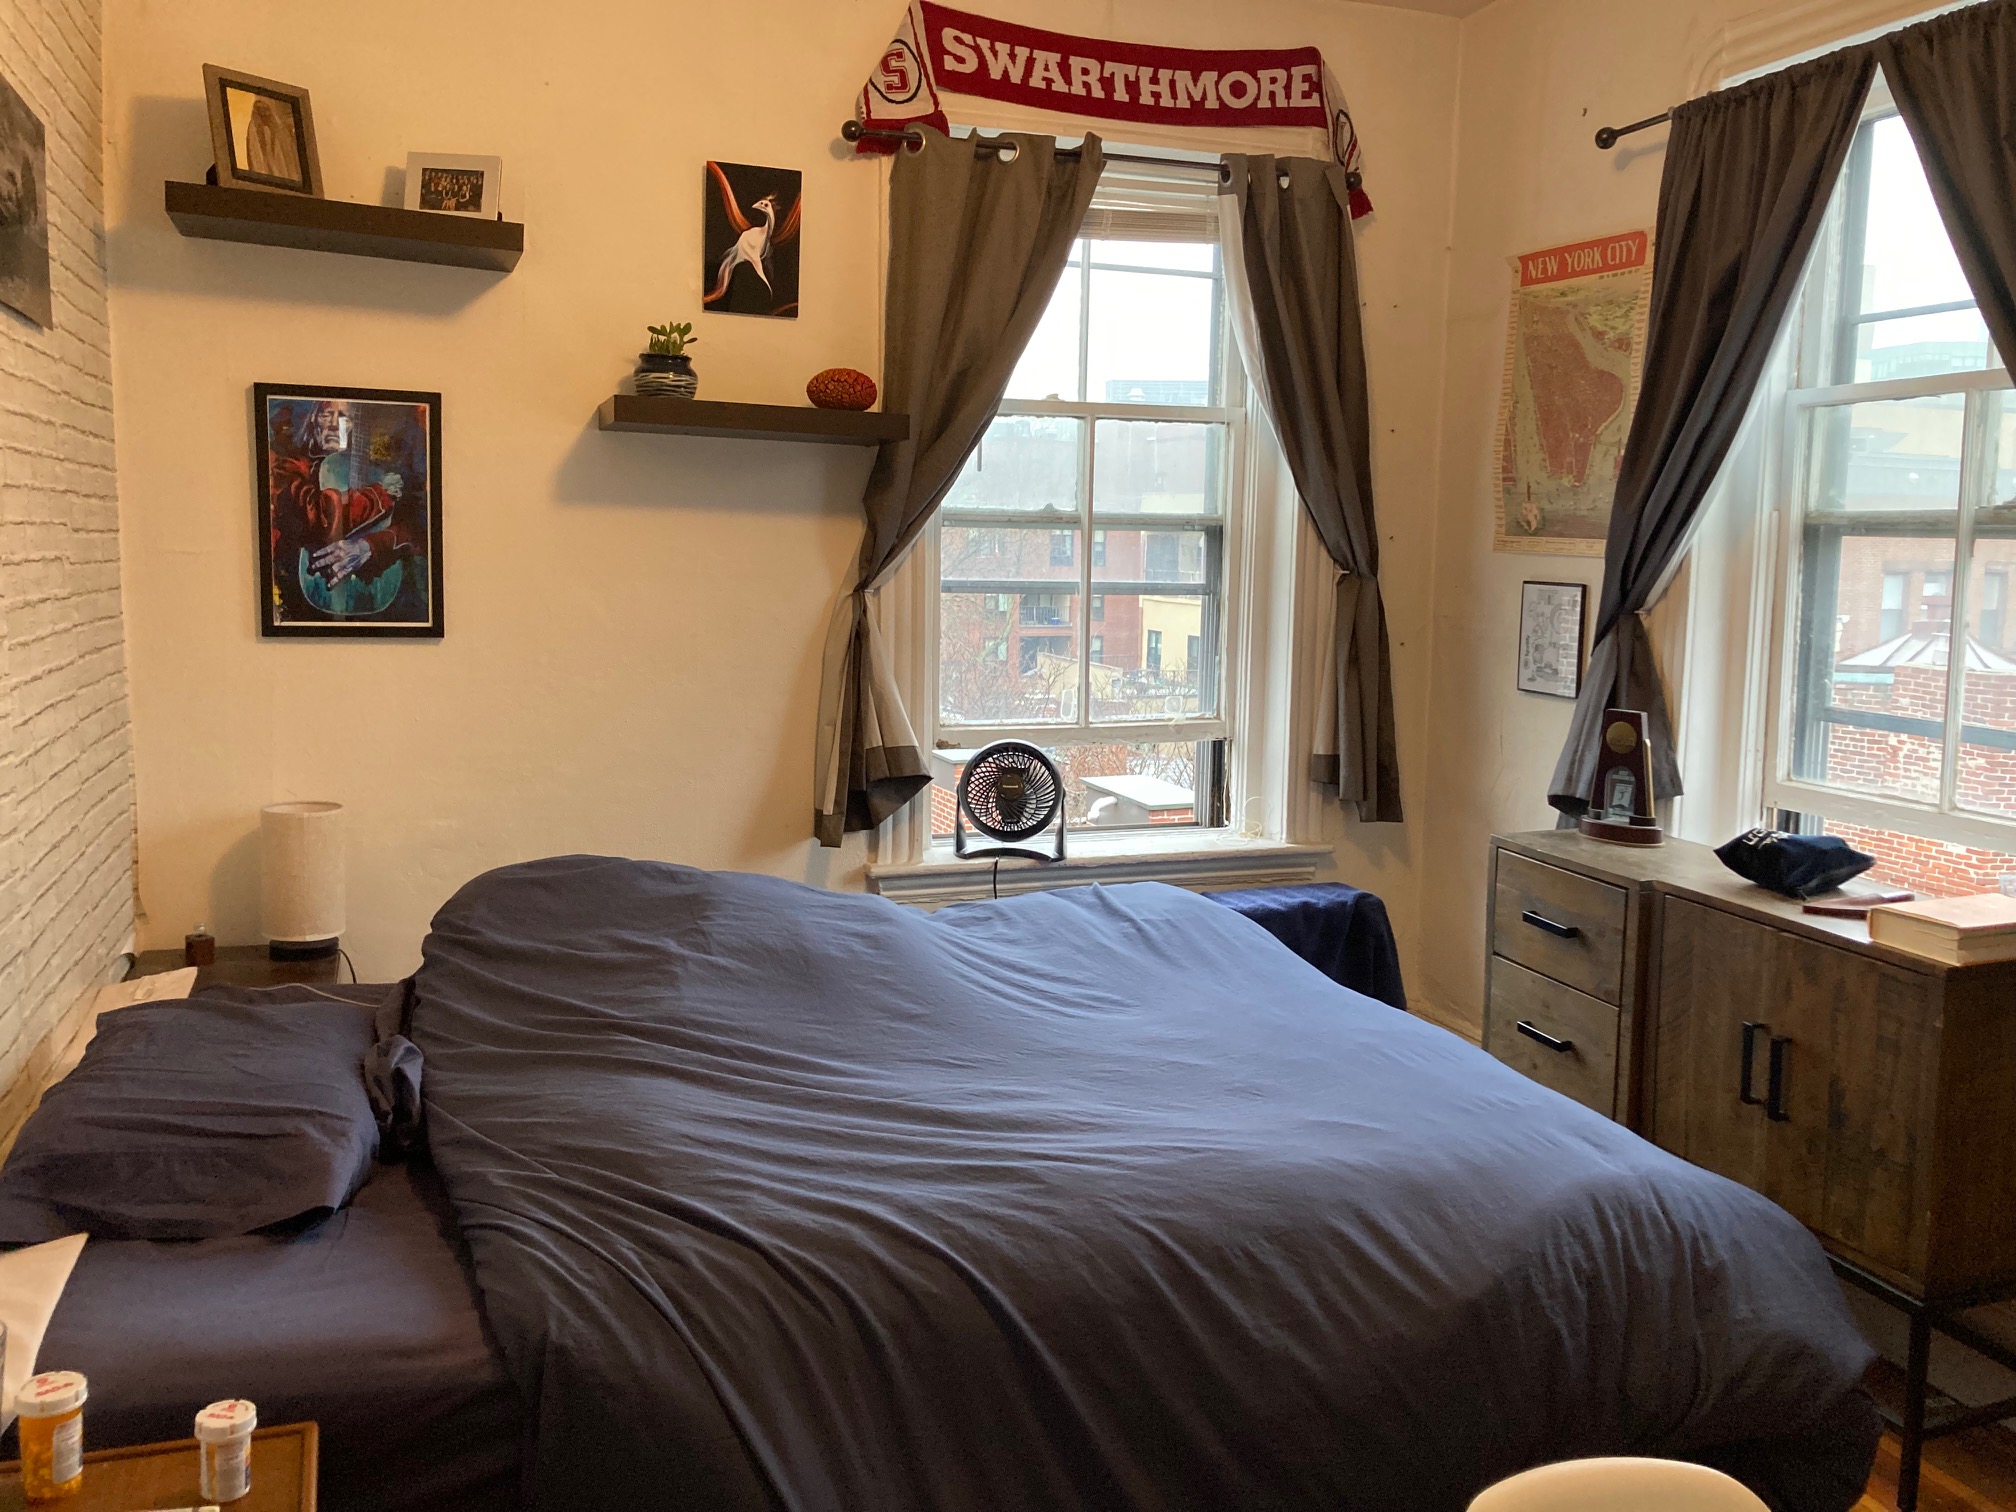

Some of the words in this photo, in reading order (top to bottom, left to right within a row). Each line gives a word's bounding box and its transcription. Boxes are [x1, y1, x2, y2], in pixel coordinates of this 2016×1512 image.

[881, 48, 910, 93] S
[941, 26, 1321, 109] SWARTHMORE
[1527, 255, 1559, 280] NEW
[1564, 245, 1602, 273] YORK
[1606, 238, 1640, 265] CITY
